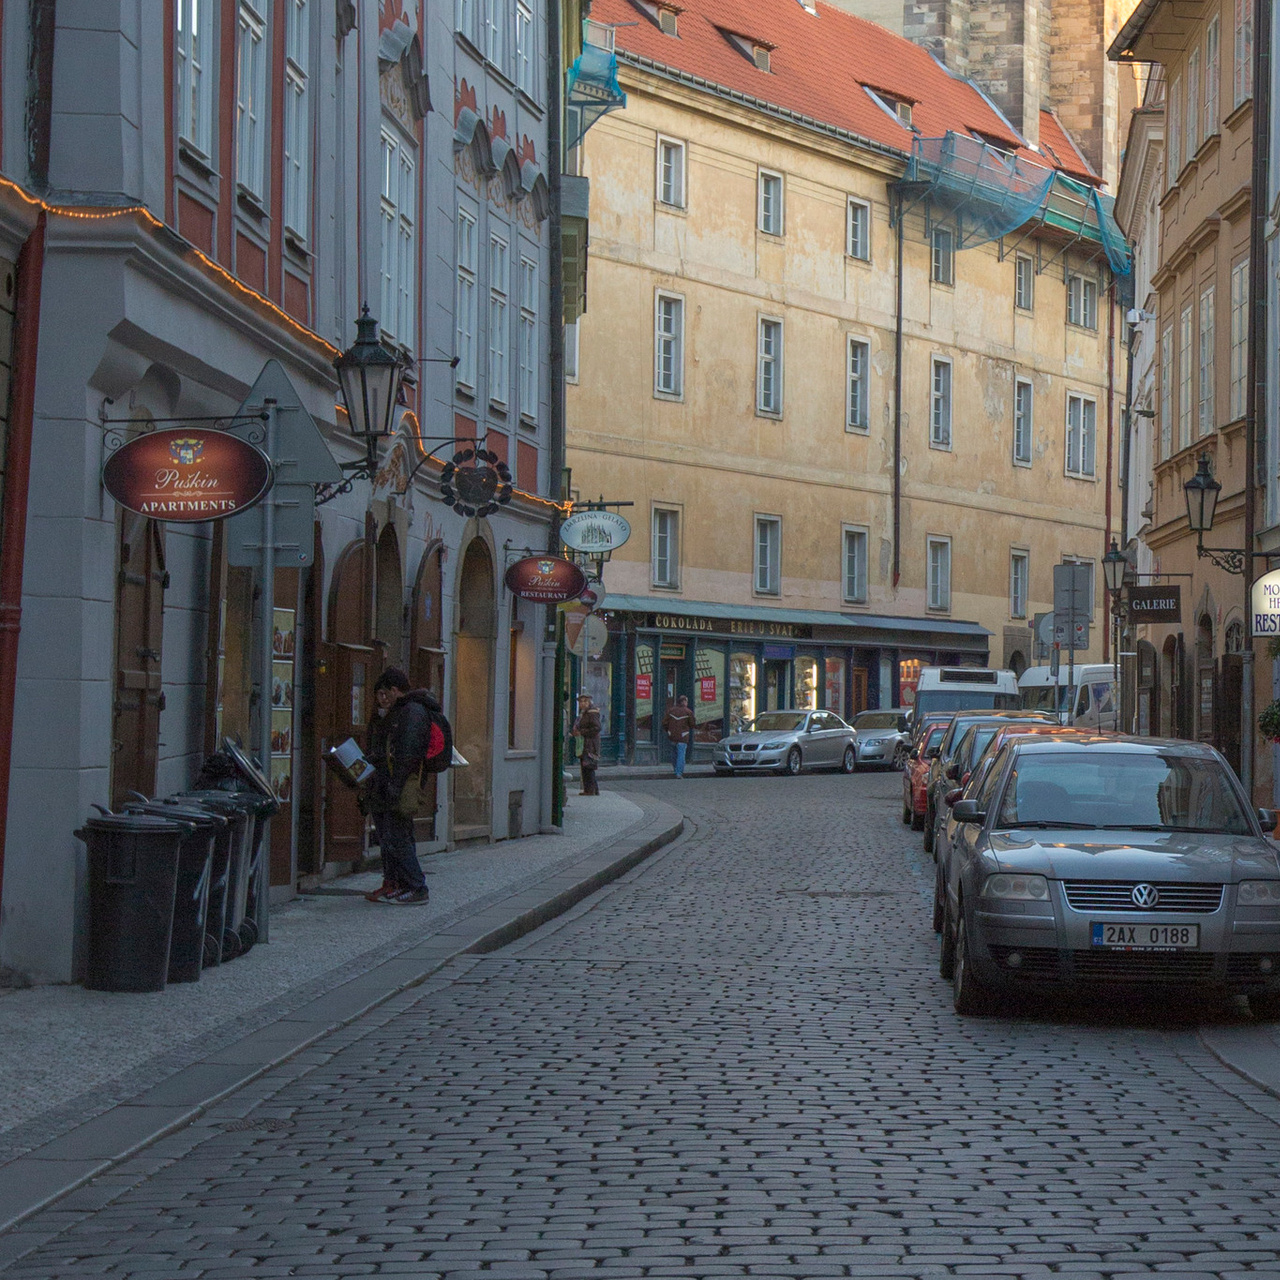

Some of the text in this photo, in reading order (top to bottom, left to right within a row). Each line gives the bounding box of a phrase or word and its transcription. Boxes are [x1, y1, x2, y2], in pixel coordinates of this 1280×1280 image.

[154, 468, 220, 490] Puškin
[139, 499, 237, 513] APARTMENTS
[563, 514, 627, 532] ZMRZLINA GELATO
[528, 575, 561, 587] Puškin
[520, 590, 568, 600] RESTAURANT
[1132, 598, 1176, 611] GALERIE
[655, 614, 713, 631] ČOKOLÁDA
[1106, 926, 1190, 944] 2AX 0188
